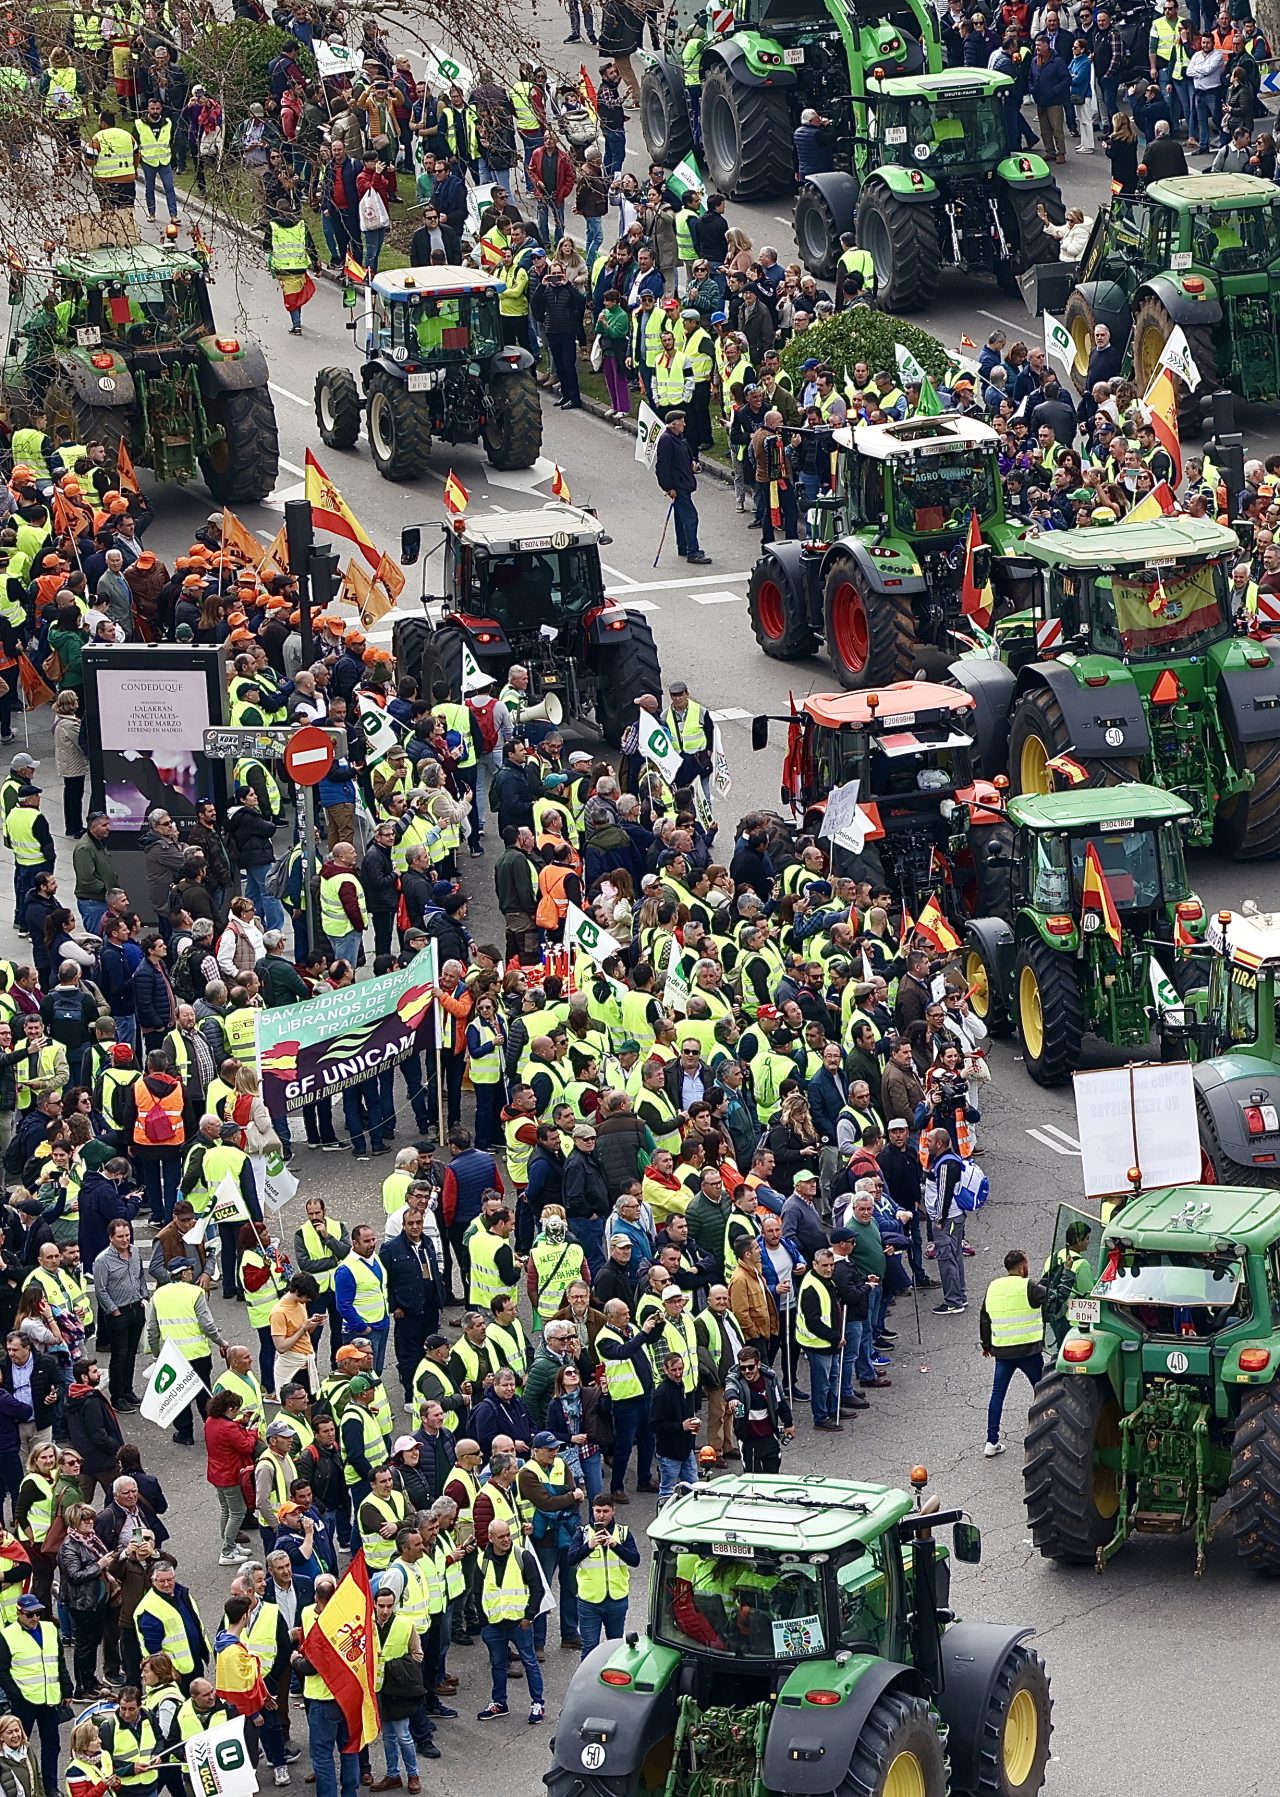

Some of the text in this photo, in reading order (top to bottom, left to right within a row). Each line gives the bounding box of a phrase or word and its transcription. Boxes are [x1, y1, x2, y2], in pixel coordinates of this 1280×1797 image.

[917, 147, 927, 157] 50
[395, 348, 405, 360] 40
[103, 379, 112, 389] 40
[914, 471, 939, 483] AGRO
[555, 531, 566, 547] 40
[120, 683, 184, 693] CONDEDUQUE
[1109, 729, 1121, 744] 50
[1085, 915, 1095, 930] 40
[262, 1006, 293, 1025] SAN
[297, 988, 354, 1012] ISIDRO
[276, 1000, 360, 1034] LIBRANOS
[363, 991, 385, 1008] DE
[315, 1002, 382, 1035] TRAIDOR
[284, 1028, 414, 1096] 6F UNICAM
[285, 1044, 412, 1109] UNIDAD E INDEPENDENCIA DEL CAMPO
[1079, 1301, 1097, 1310] 0792
[1170, 1353, 1184, 1371] 40
[586, 1746, 600, 1768] 50
